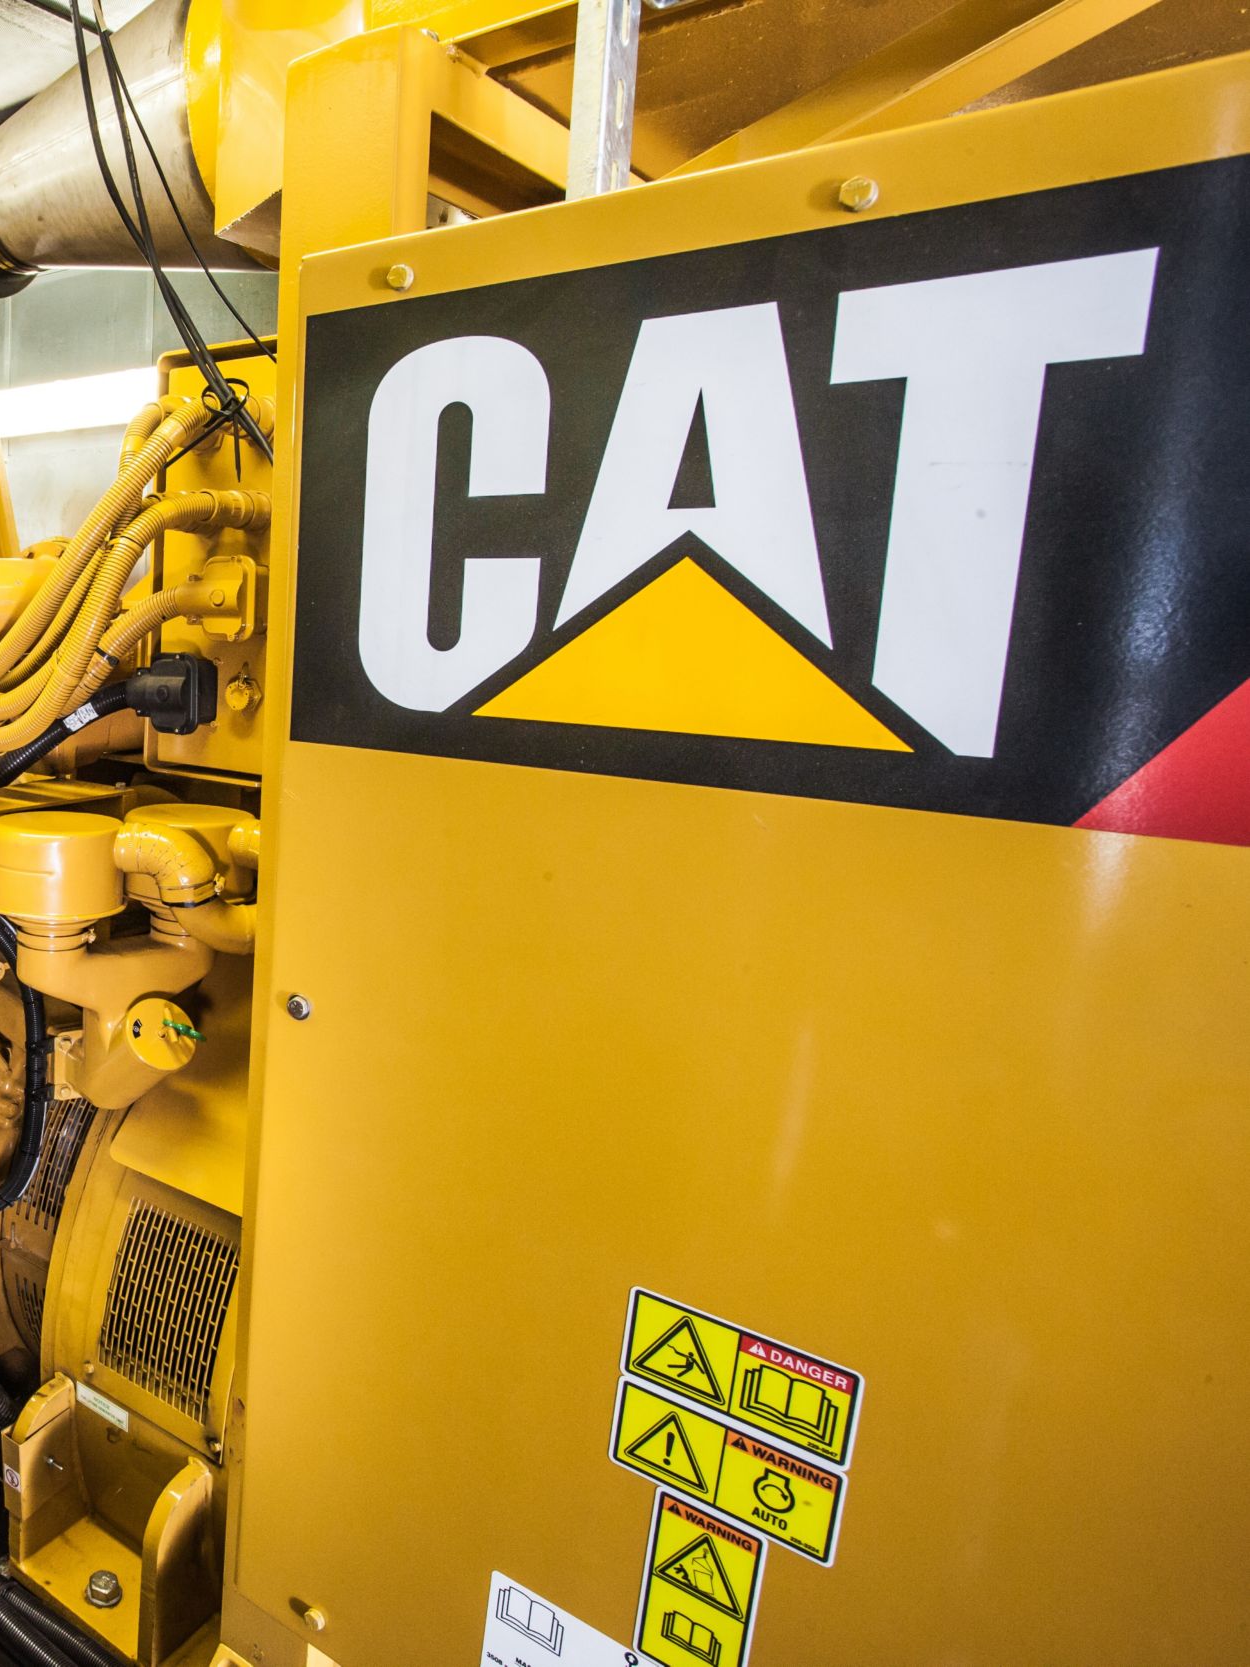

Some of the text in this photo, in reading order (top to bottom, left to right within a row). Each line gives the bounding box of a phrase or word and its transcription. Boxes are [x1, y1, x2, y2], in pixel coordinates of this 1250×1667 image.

[358, 247, 1159, 758] CAT
[770, 1349, 848, 1390] DANGER
[752, 1444, 833, 1490] WARNING
[685, 1510, 752, 1552] WARNING
[752, 1506, 788, 1531] AUTO
